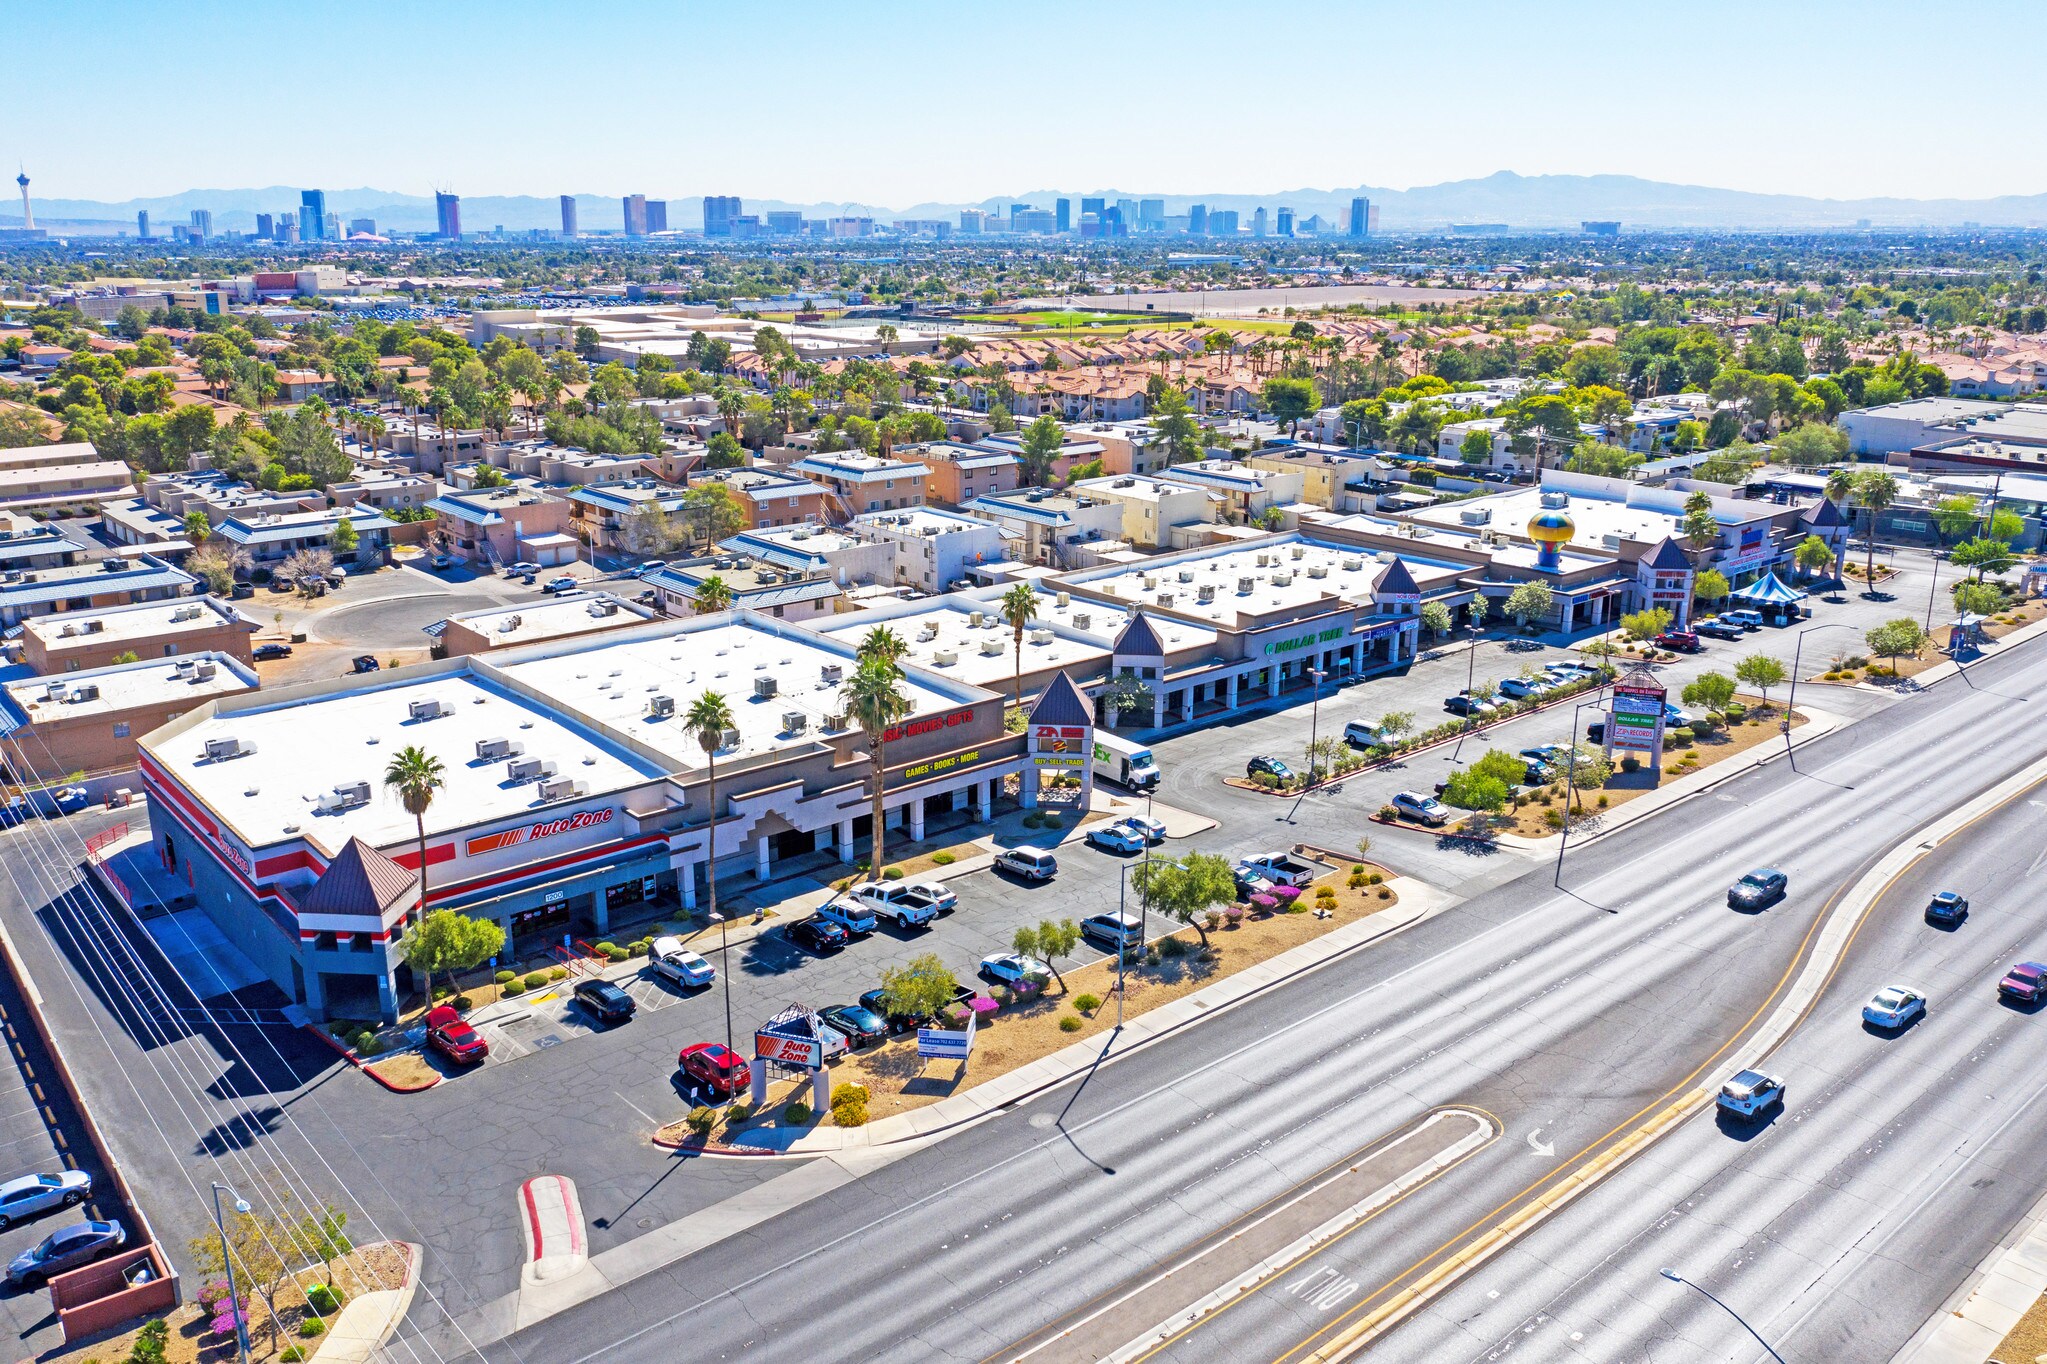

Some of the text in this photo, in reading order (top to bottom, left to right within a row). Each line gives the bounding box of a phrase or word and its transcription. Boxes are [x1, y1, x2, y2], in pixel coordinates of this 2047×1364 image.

[1653, 591, 1685, 599] MATTRESS
[1275, 634, 1316, 654] DOLLAR
[1319, 627, 1344, 643] TREE
[907, 717, 943, 737] MOVIES
[947, 709, 974, 727] GIFTS
[1630, 729, 1652, 737] RECORDS
[905, 750, 979, 778] GAMES BOOKS MORE
[529, 807, 614, 841] AutoZone
[546, 891, 563, 901] 1200
[778, 1049, 808, 1063] Zone
[784, 1040, 812, 1054] Auto
[1285, 1265, 1359, 1311] ONLY
